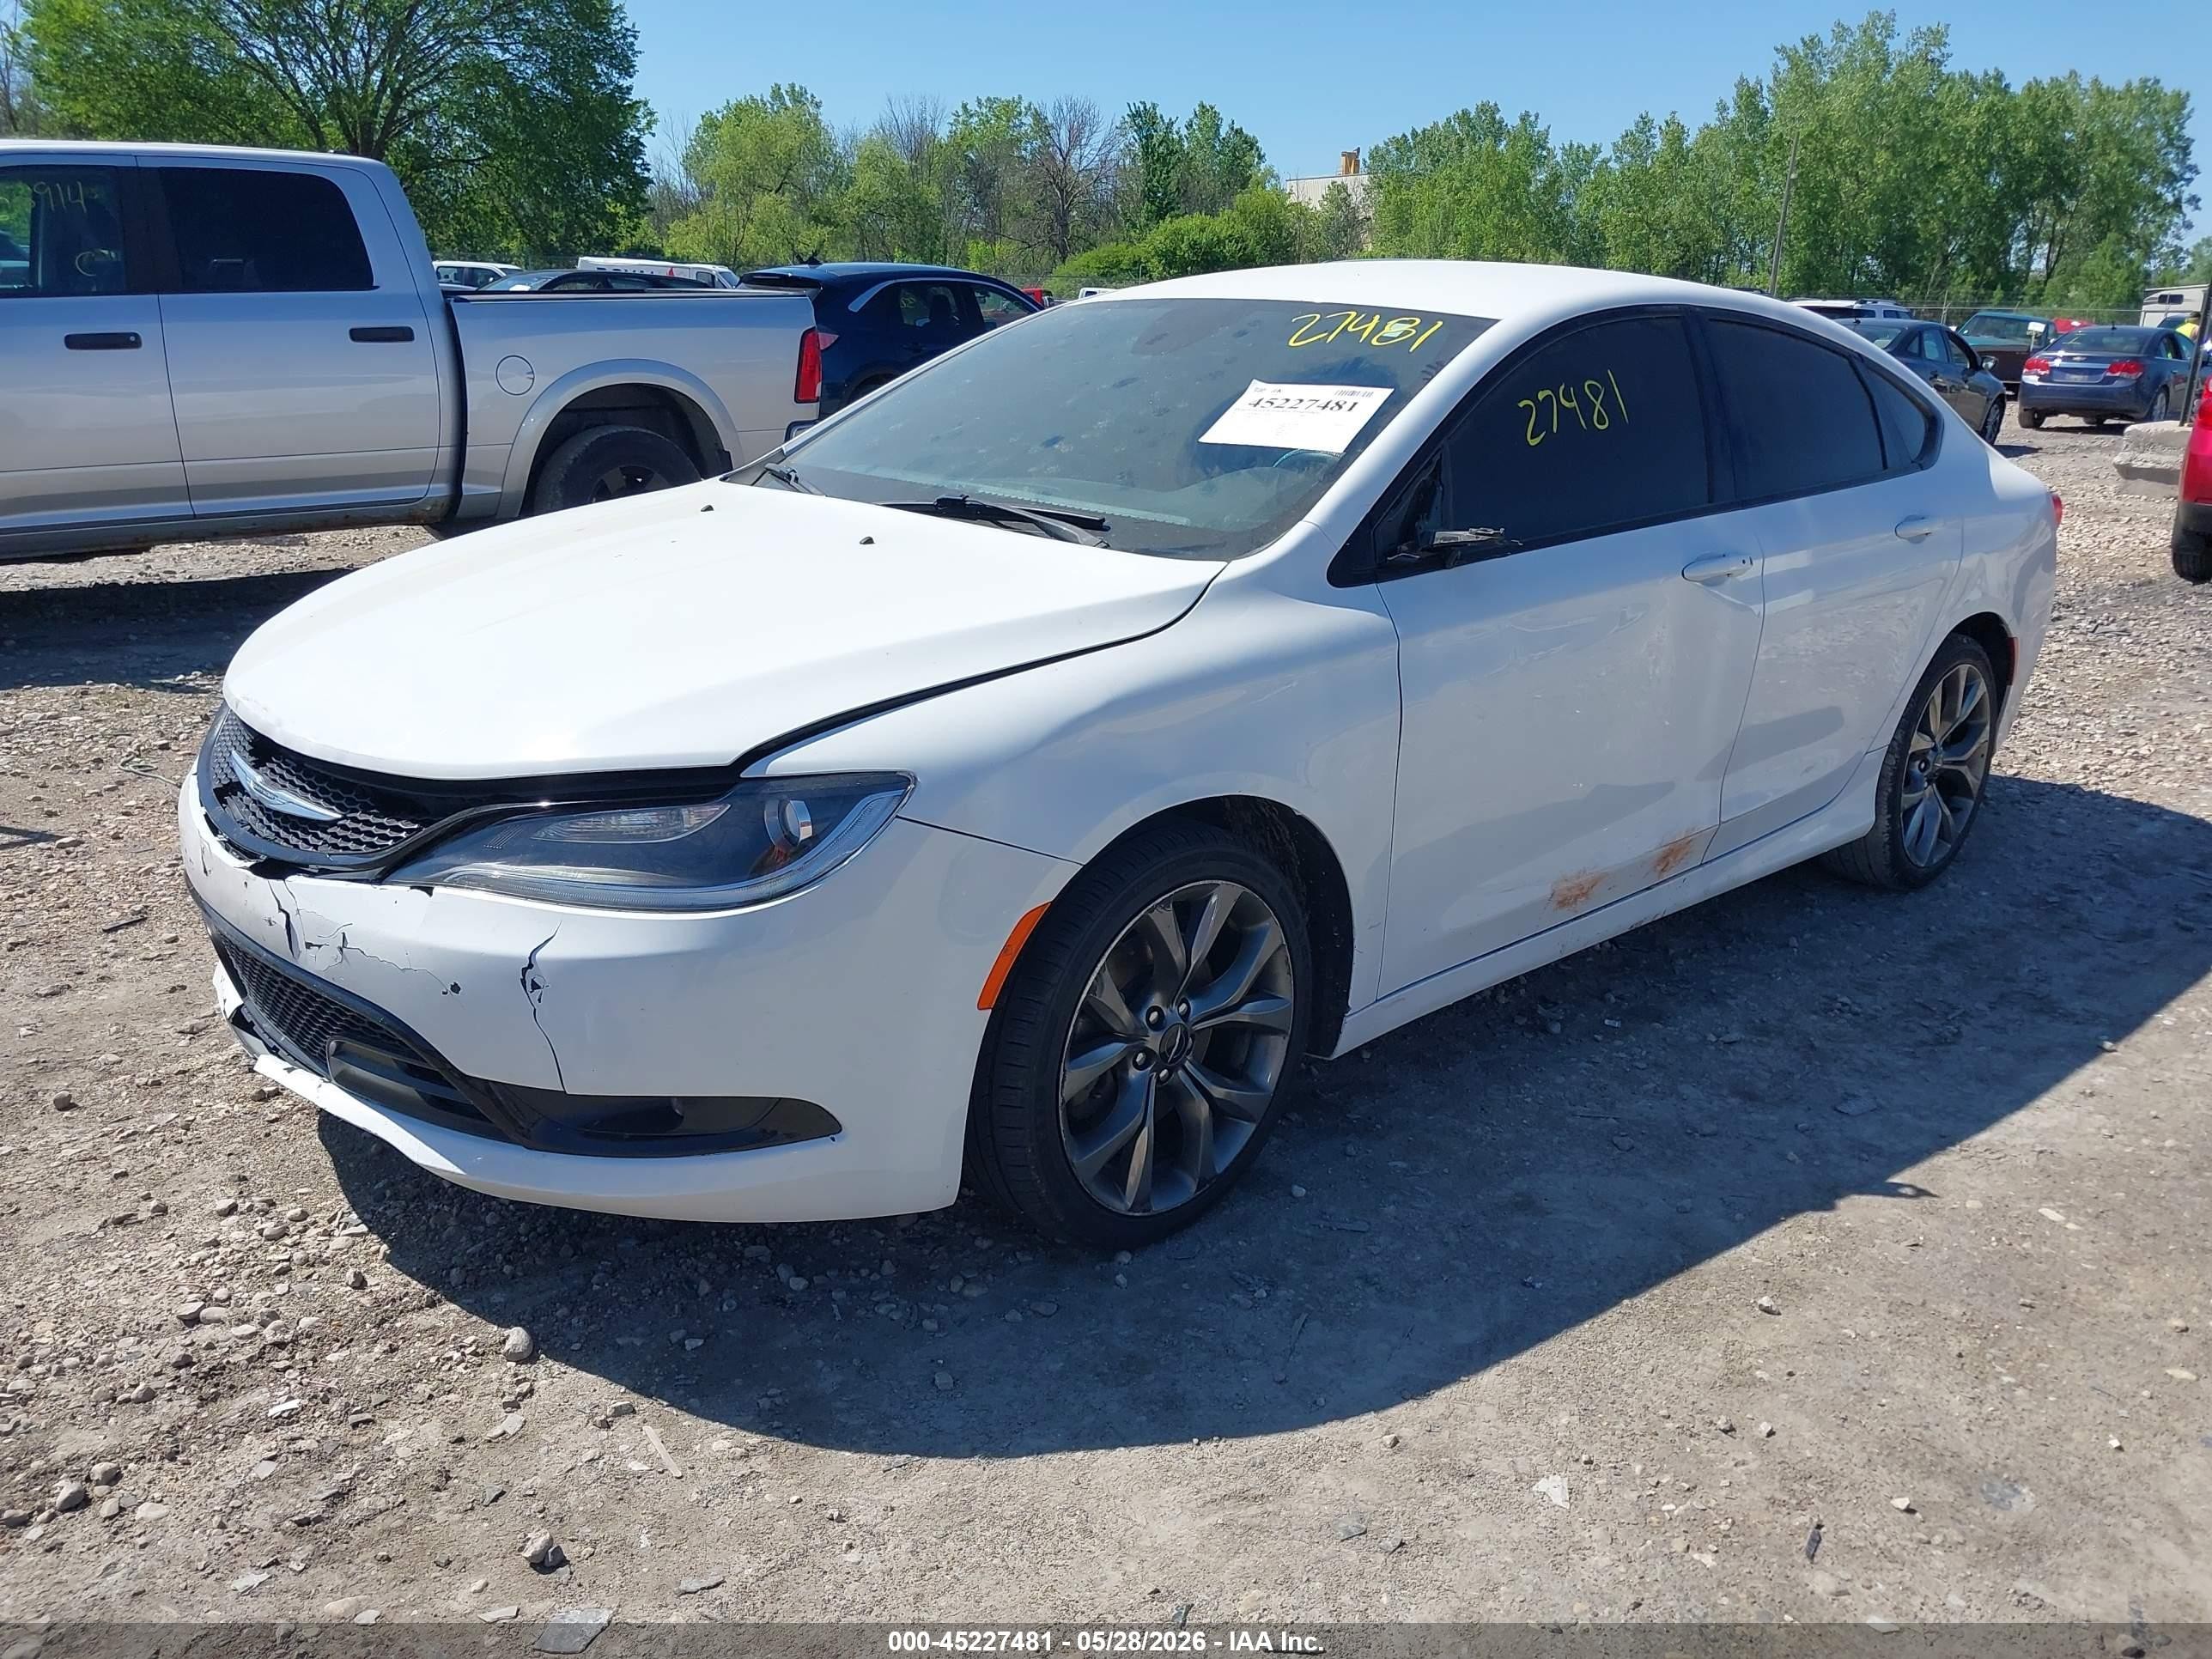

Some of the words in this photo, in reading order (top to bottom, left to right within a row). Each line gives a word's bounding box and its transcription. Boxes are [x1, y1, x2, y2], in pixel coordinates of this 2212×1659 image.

[1288, 311, 1443, 352] 27481
[1249, 398, 1359, 411] 45227481
[1517, 369, 1628, 446] 27481
